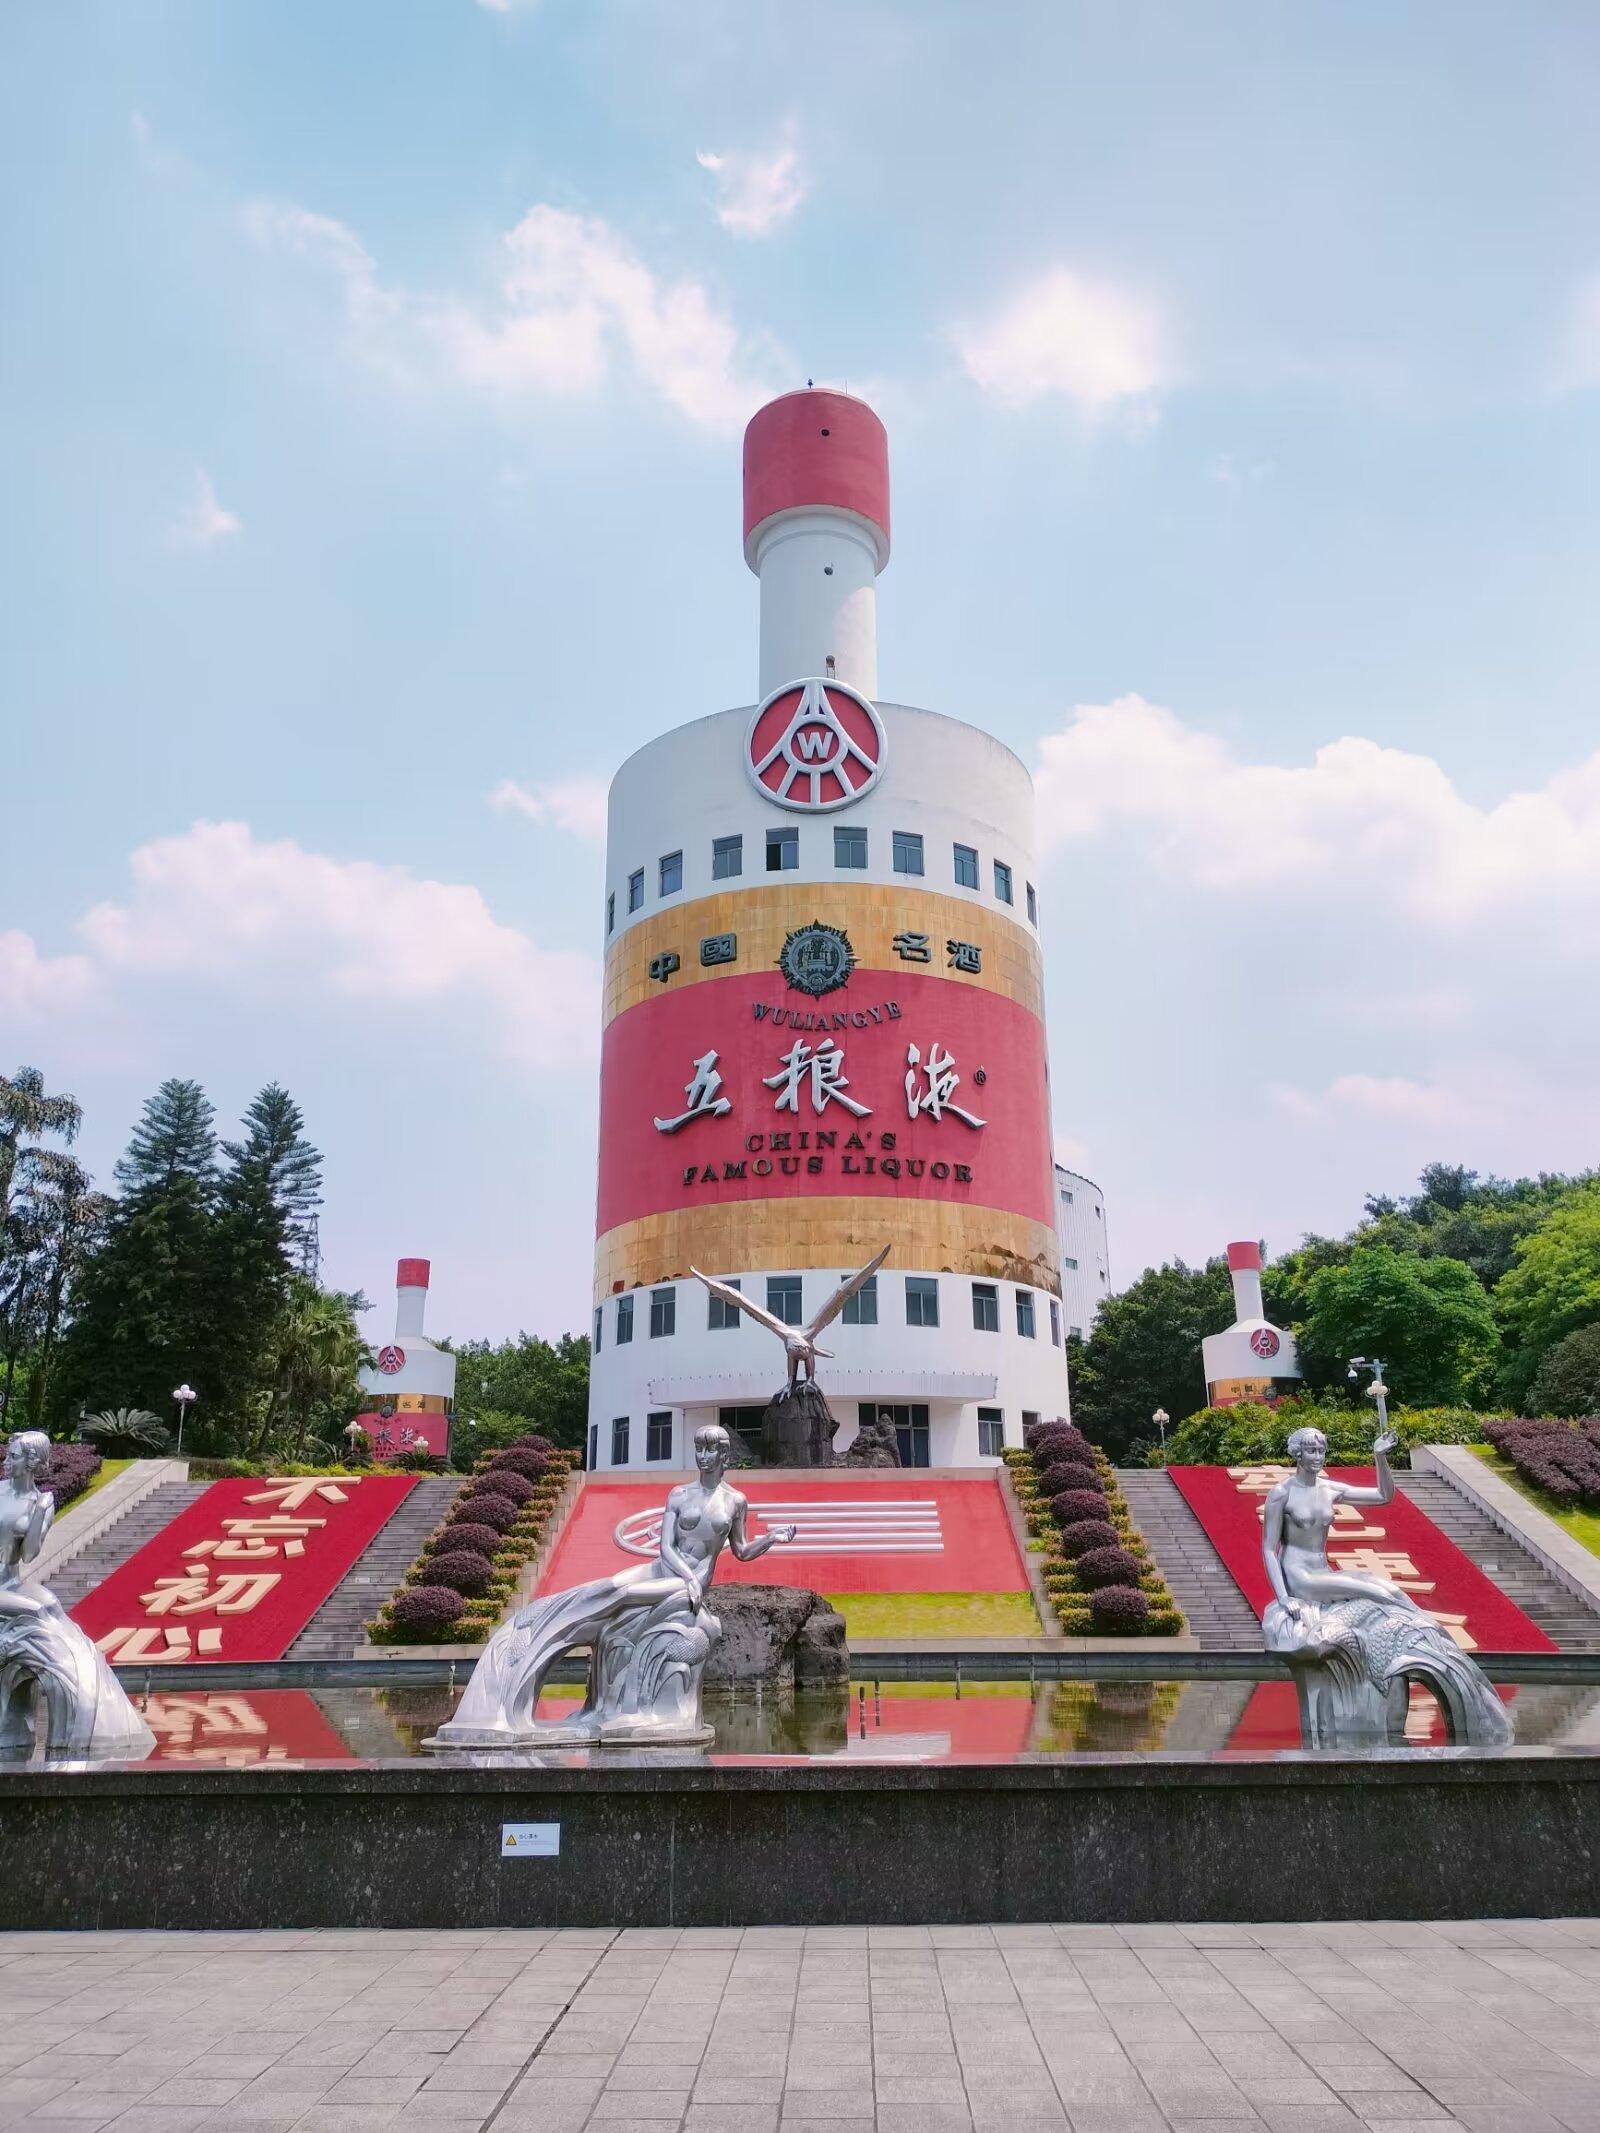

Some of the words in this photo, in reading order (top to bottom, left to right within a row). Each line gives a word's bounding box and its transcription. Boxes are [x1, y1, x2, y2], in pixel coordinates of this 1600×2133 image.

[796, 731, 834, 760] W
[892, 931, 982, 975] 名酒
[752, 1001, 903, 1031] WULIANGYE
[653, 1038, 987, 1134] 五粮液
[745, 1131, 897, 1152] CHINA'S
[682, 1156, 824, 1186] FAMOUS
[841, 1156, 974, 1184] LIQUOR
[94, 1476, 362, 1663] 不忘初心
